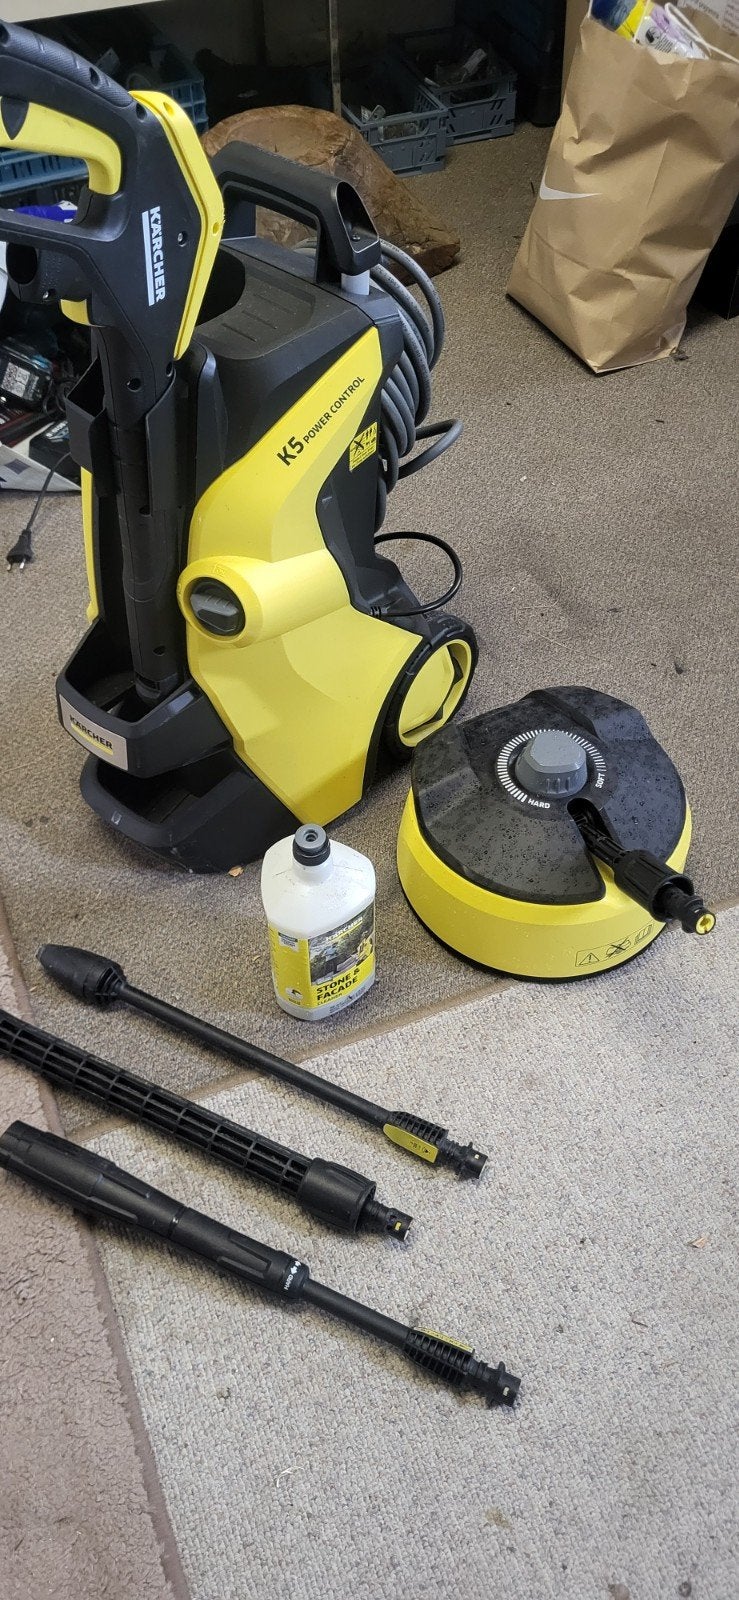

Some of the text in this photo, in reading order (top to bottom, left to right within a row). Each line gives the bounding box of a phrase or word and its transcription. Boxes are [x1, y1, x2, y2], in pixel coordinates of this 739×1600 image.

[150, 205, 166, 303] KÄRCHER
[276, 376, 365, 467] K5 POWER CONTROL
[595, 772, 606, 789] SOFT
[527, 798, 551, 809] HARD
[316, 972, 351, 995] STONE
[317, 976, 358, 1001] FACADE
[283, 1274, 294, 1290] HARD
